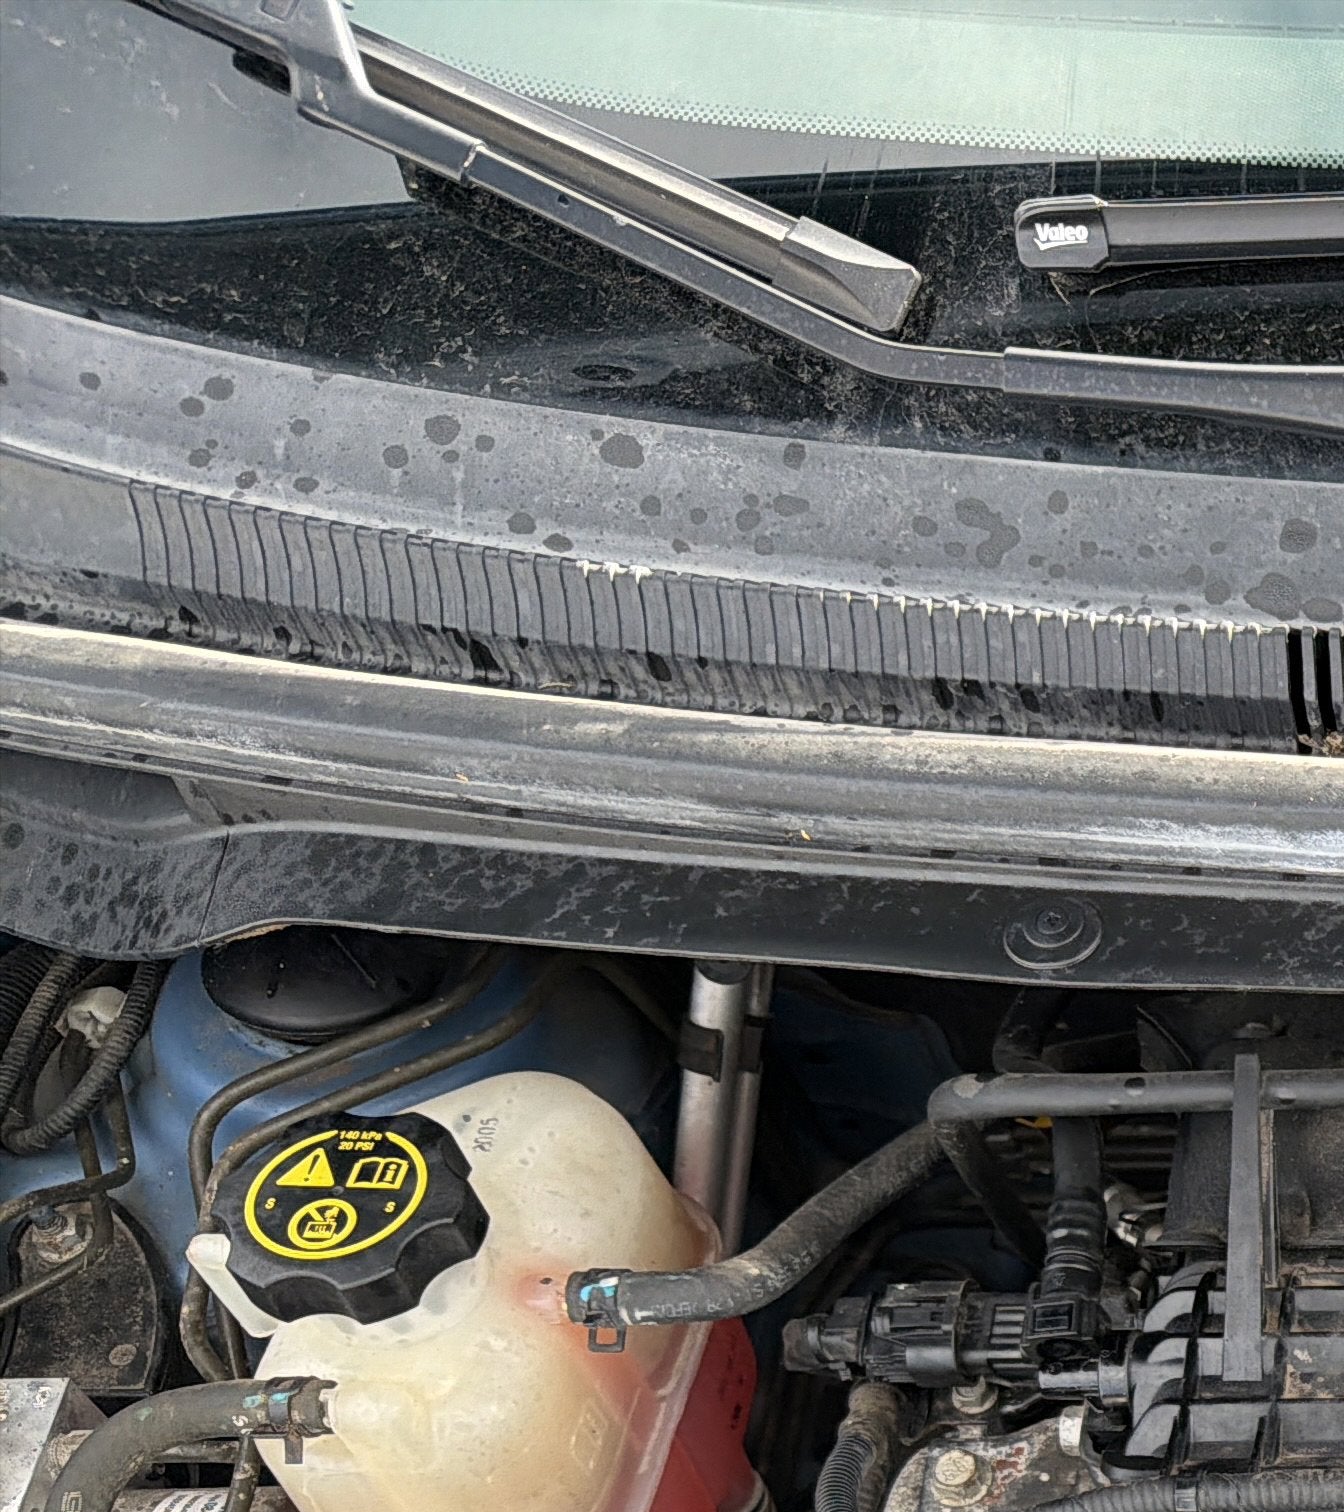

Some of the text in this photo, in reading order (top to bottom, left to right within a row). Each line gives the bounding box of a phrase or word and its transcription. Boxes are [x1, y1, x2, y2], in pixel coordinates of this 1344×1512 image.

[1035, 223, 1088, 241] Valeo
[338, 1131, 358, 1140] 140
[338, 1141, 374, 1151] 20 PSI
[265, 1198, 276, 1209] S
[385, 1201, 396, 1214] S
